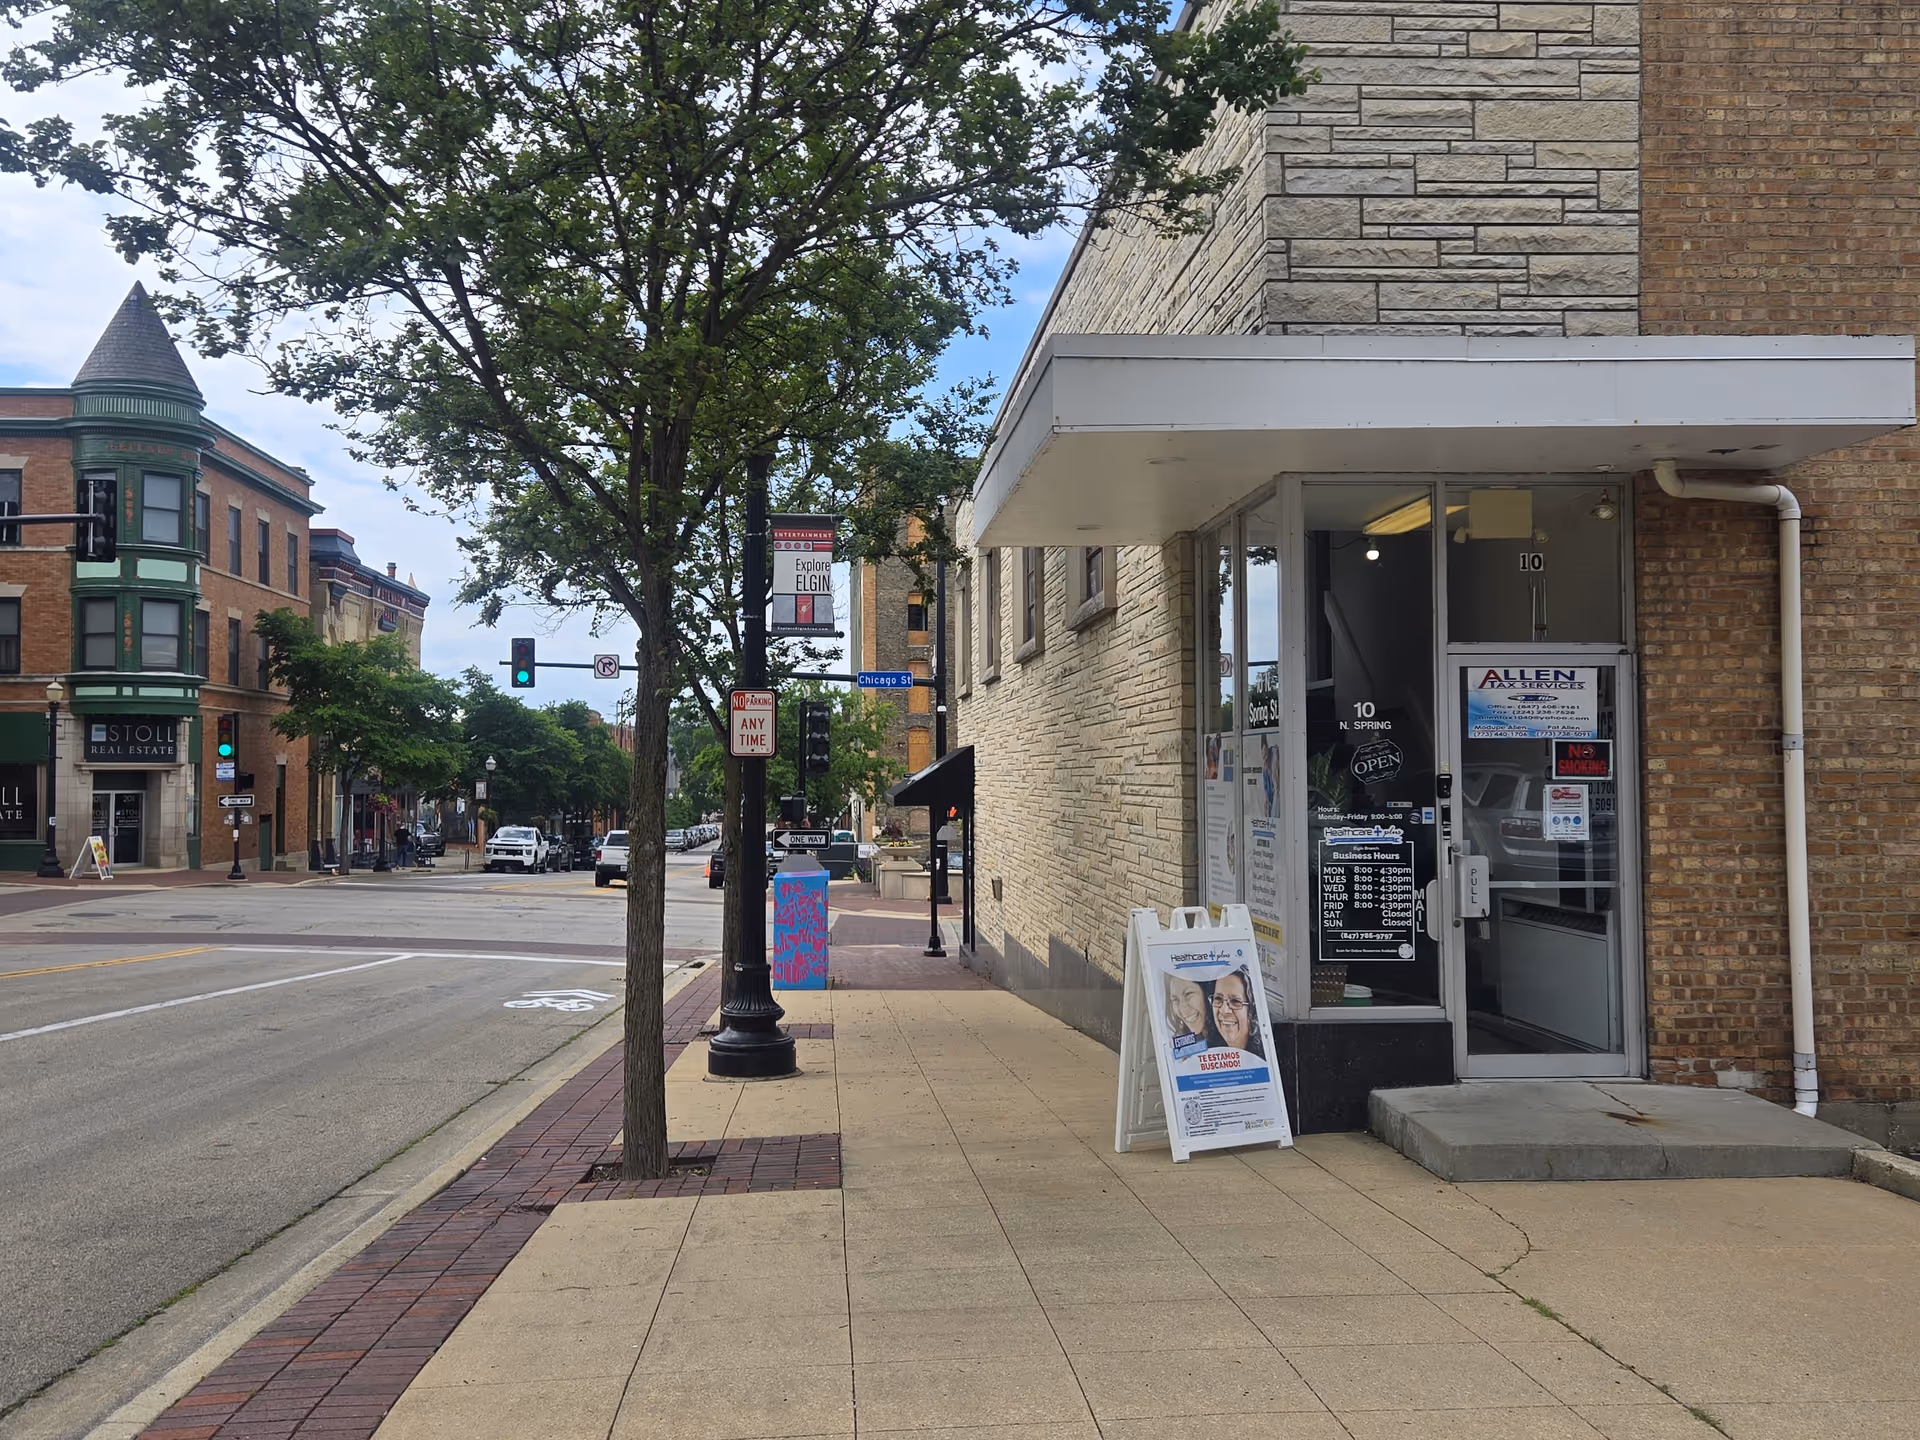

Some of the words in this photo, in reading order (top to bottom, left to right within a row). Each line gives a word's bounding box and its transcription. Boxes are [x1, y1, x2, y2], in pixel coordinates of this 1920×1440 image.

[796, 558, 831, 574] Explore
[1520, 554, 1542, 570] 10
[796, 574, 830, 592] ELGIN
[859, 675, 897, 687] Chicago
[901, 675, 911, 684] St
[1478, 669, 1576, 689] ALLEN
[1489, 681, 1518, 689] TAX
[733, 695, 745, 708] NO
[746, 696, 772, 706] PARKING
[1249, 701, 1269, 726] Spring
[1353, 702, 1376, 718] 10
[740, 718, 765, 730] ANY
[1340, 721, 1350, 730] N.
[1354, 721, 1392, 730] SPRING
[108, 725, 174, 743] STOLL
[739, 734, 767, 746] TIME
[91, 745, 123, 754] REAL
[129, 746, 174, 755] ESTATE
[1568, 744, 1596, 759] NO
[1354, 752, 1401, 774] OPEN
[1558, 760, 1607, 774] SMOKING
[1325, 827, 1372, 836] Healthcare
[1383, 826, 1401, 837] plus
[790, 836, 806, 844] ONE
[808, 836, 824, 844] WAY
[1324, 893, 1348, 901] THUR
[1324, 902, 1344, 910] FRID
[1380, 902, 1412, 910] 4:30pm
[1414, 888, 1425, 932] MAIL
[1171, 953, 1208, 961] Healthcare
[1216, 950, 1230, 961] plus
[1198, 1054, 1207, 1062] TE
[1208, 1052, 1240, 1062] ESTAMOS
[1200, 1060, 1241, 1071] BUSCANDO!
